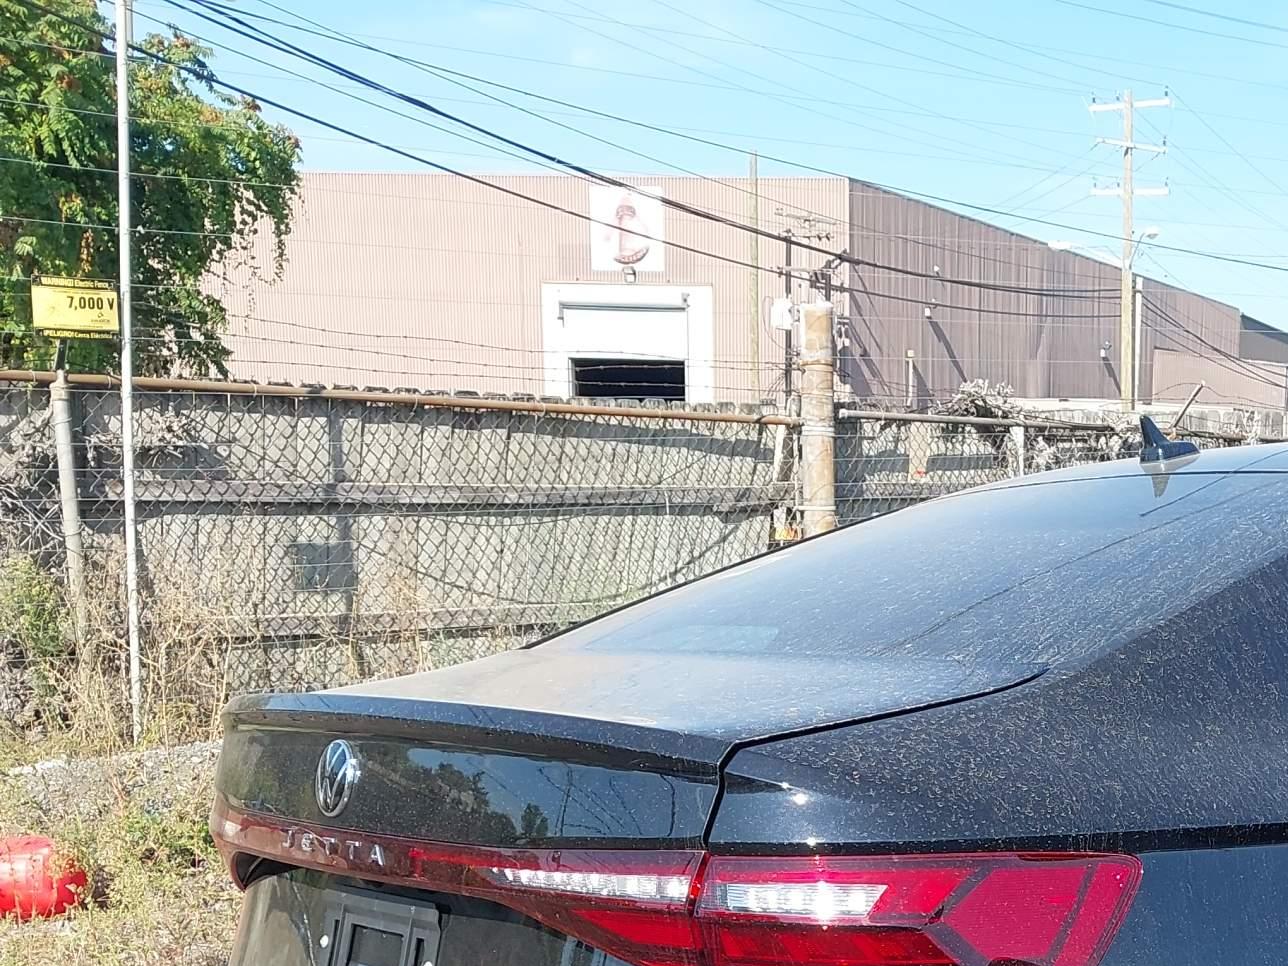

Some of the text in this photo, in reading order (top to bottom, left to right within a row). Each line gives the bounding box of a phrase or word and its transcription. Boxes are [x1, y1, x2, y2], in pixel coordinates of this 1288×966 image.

[67, 296, 115, 311] 7,000 V
[282, 826, 386, 866] JETTA
